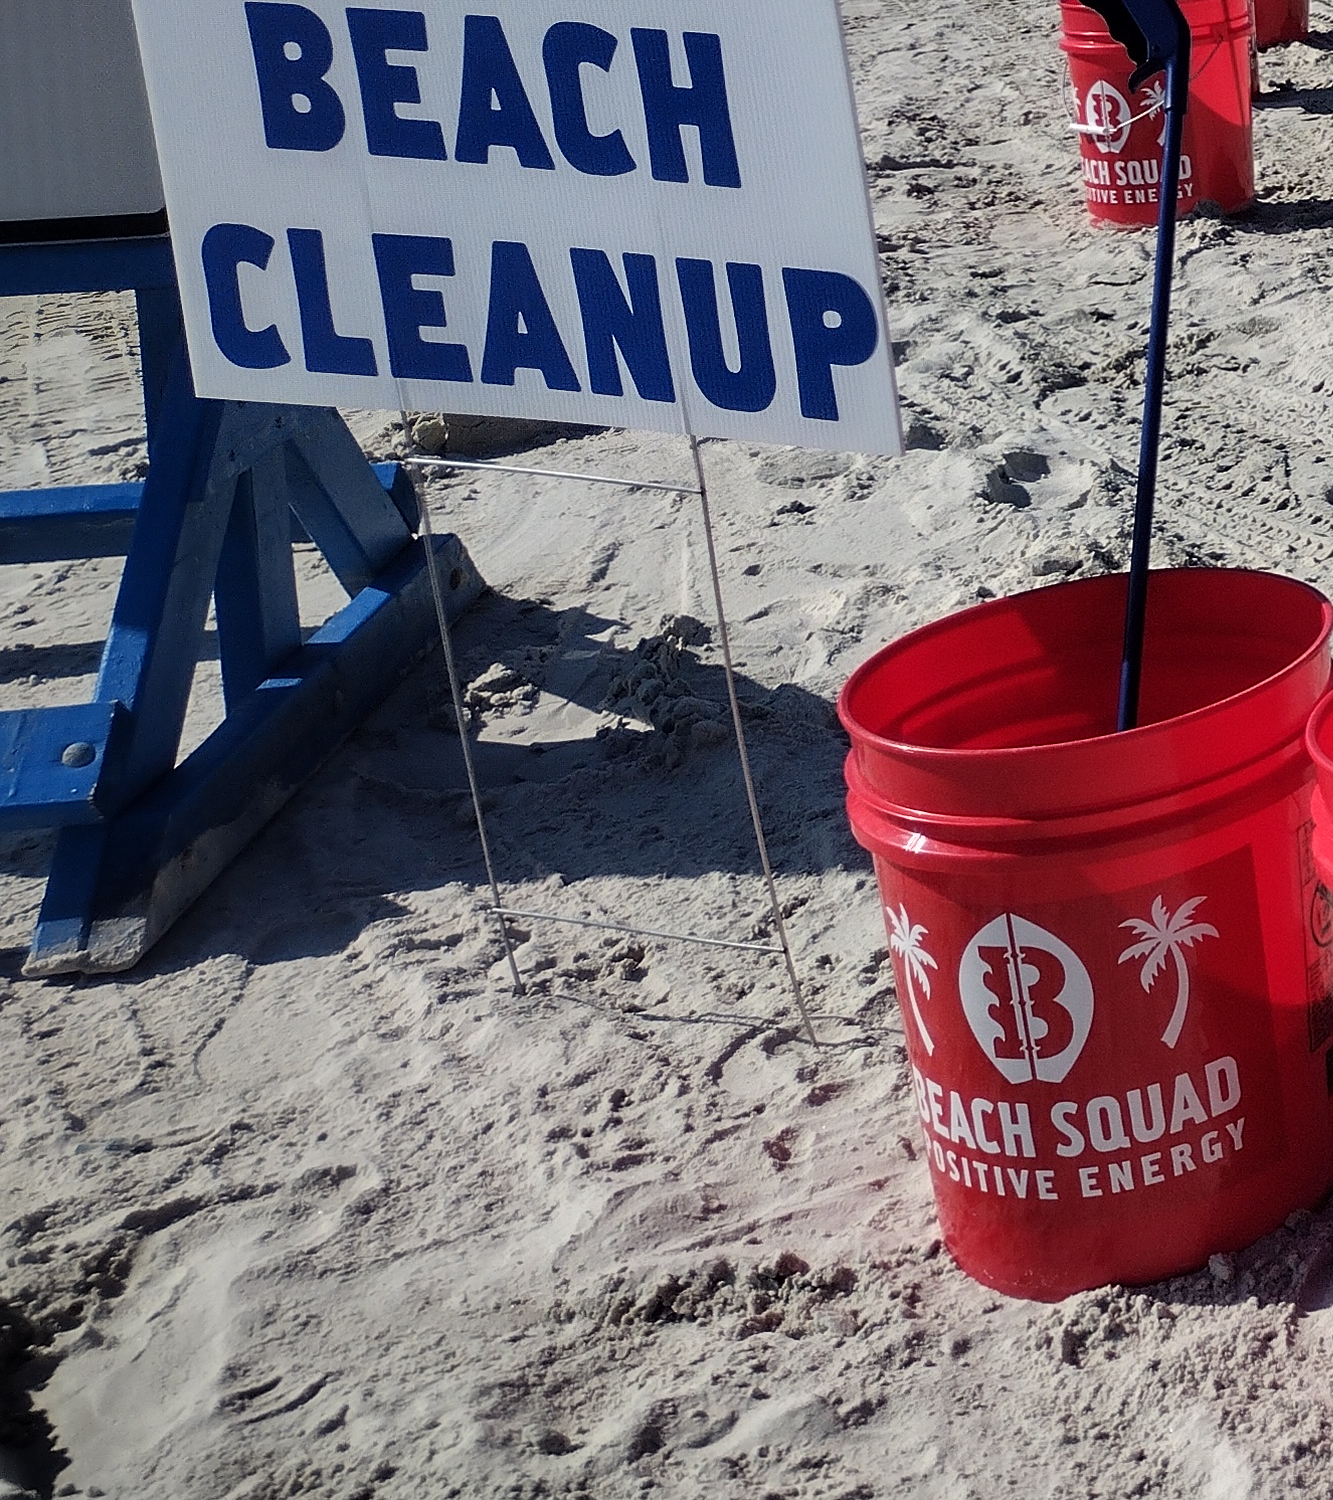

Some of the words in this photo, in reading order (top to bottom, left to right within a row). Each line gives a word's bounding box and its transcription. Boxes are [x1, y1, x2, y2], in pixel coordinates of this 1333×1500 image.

[244, 1, 741, 188] BEACH
[1114, 155, 1192, 186] SQUD
[201, 223, 879, 421] CLEANUP
[912, 1064, 1036, 1158] BEACH
[1051, 1056, 1242, 1157] SQUAD
[924, 1128, 1058, 1200] POSITIVE
[1079, 1117, 1245, 1198] ENERGY
